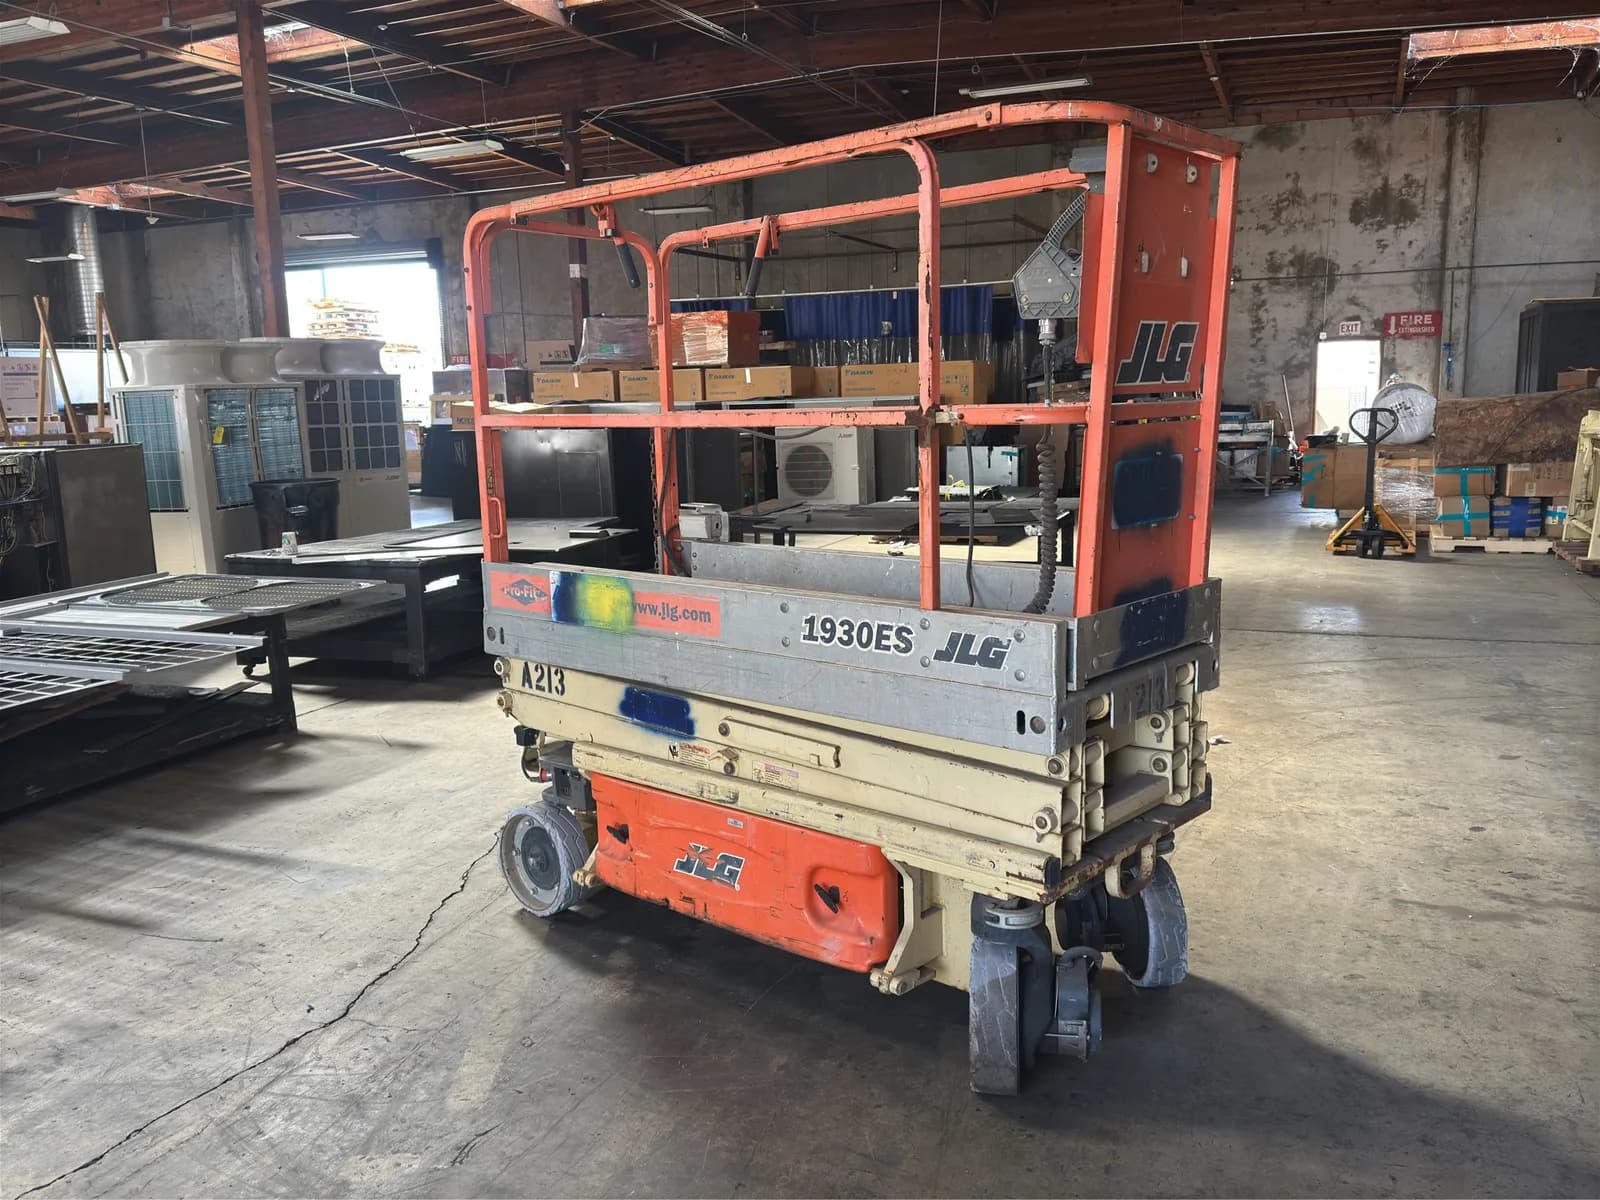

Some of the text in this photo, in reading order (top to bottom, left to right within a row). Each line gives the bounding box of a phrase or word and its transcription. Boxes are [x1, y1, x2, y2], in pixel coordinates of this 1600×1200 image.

[1341, 323, 1359, 333] EXIT
[1398, 327, 1436, 335] EXTINGUISHER
[1400, 315, 1433, 325] FIRE
[1115, 321, 1199, 385] JLG
[803, 615, 914, 655] 1930ES
[933, 631, 1012, 669] JLG
[521, 661, 566, 696] A213
